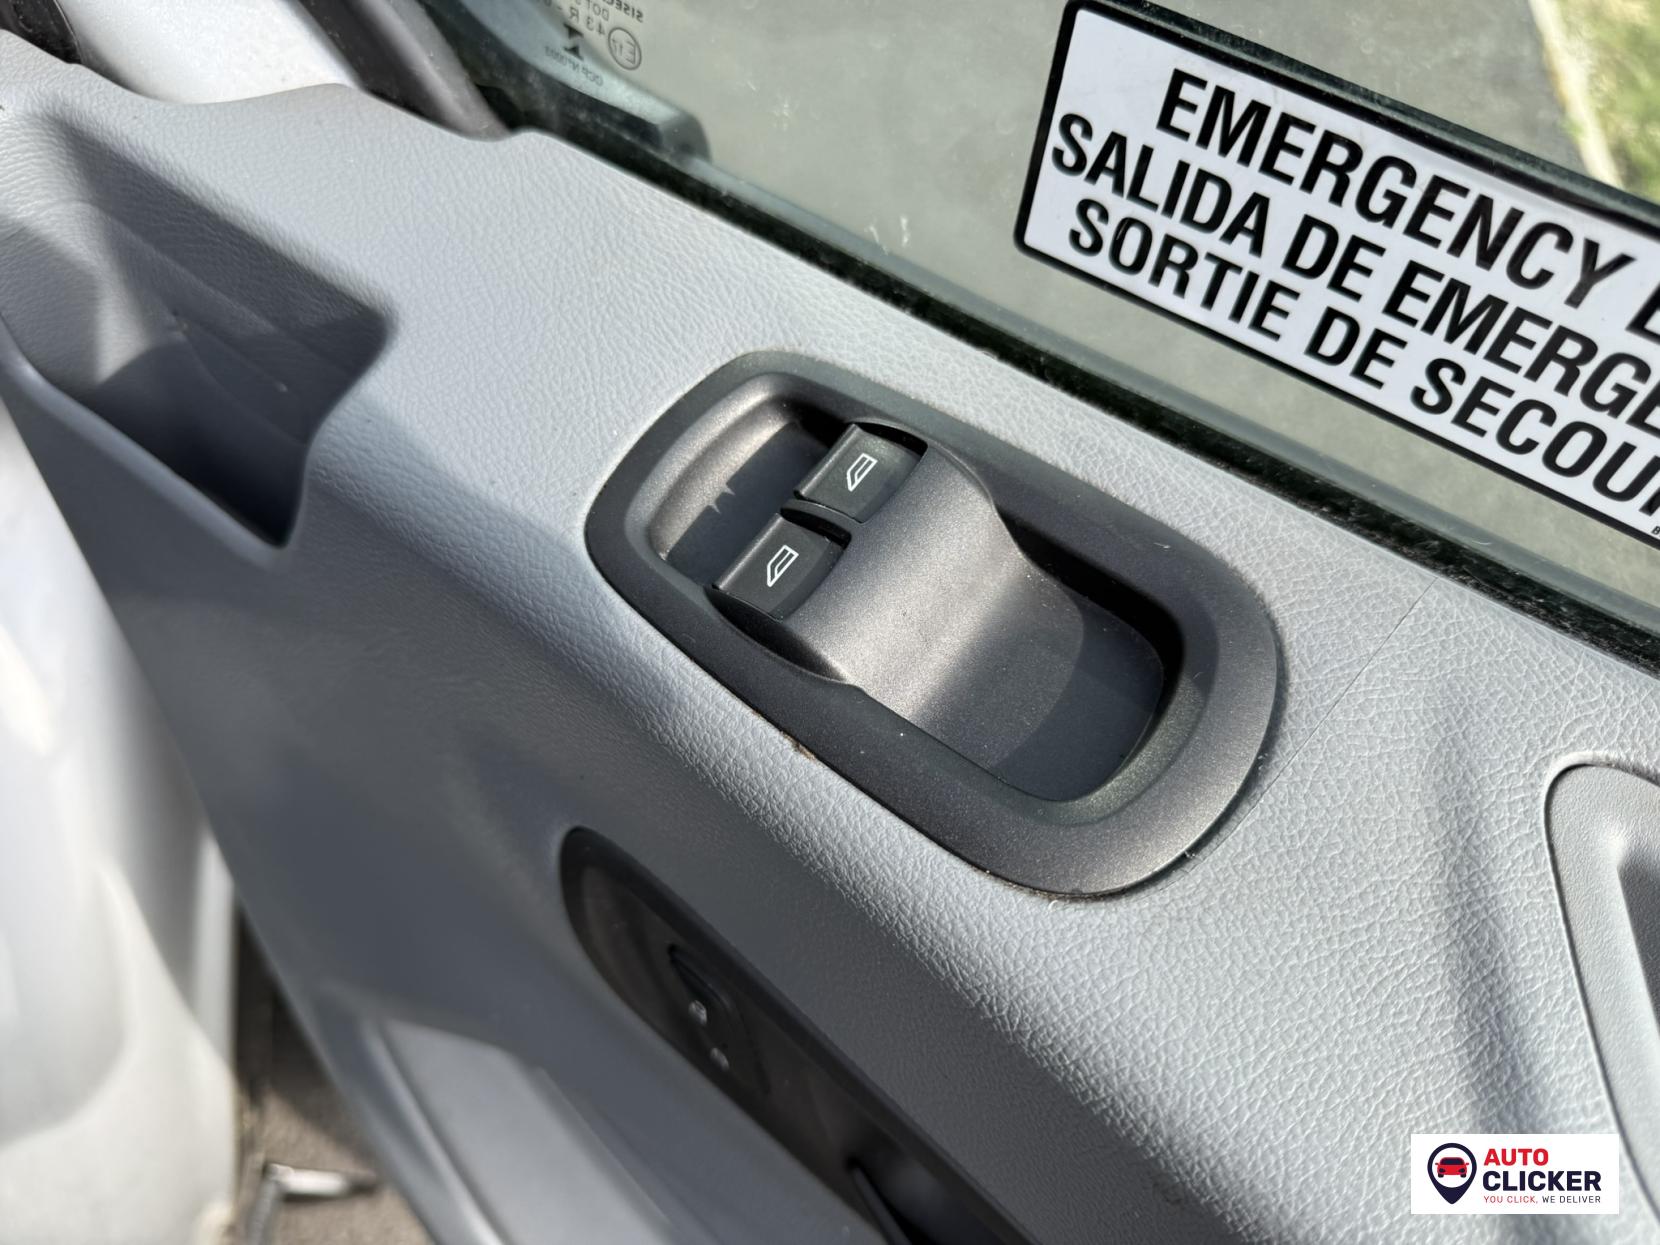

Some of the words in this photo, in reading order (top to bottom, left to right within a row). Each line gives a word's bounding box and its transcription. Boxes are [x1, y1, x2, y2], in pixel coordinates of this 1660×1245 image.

[1051, 113, 1270, 258] SALIDA
[1281, 213, 1387, 302] DE
[1156, 68, 1637, 309] EMERGENCY
[1069, 198, 1300, 341] SORTIE
[1304, 306, 1408, 390] DE
